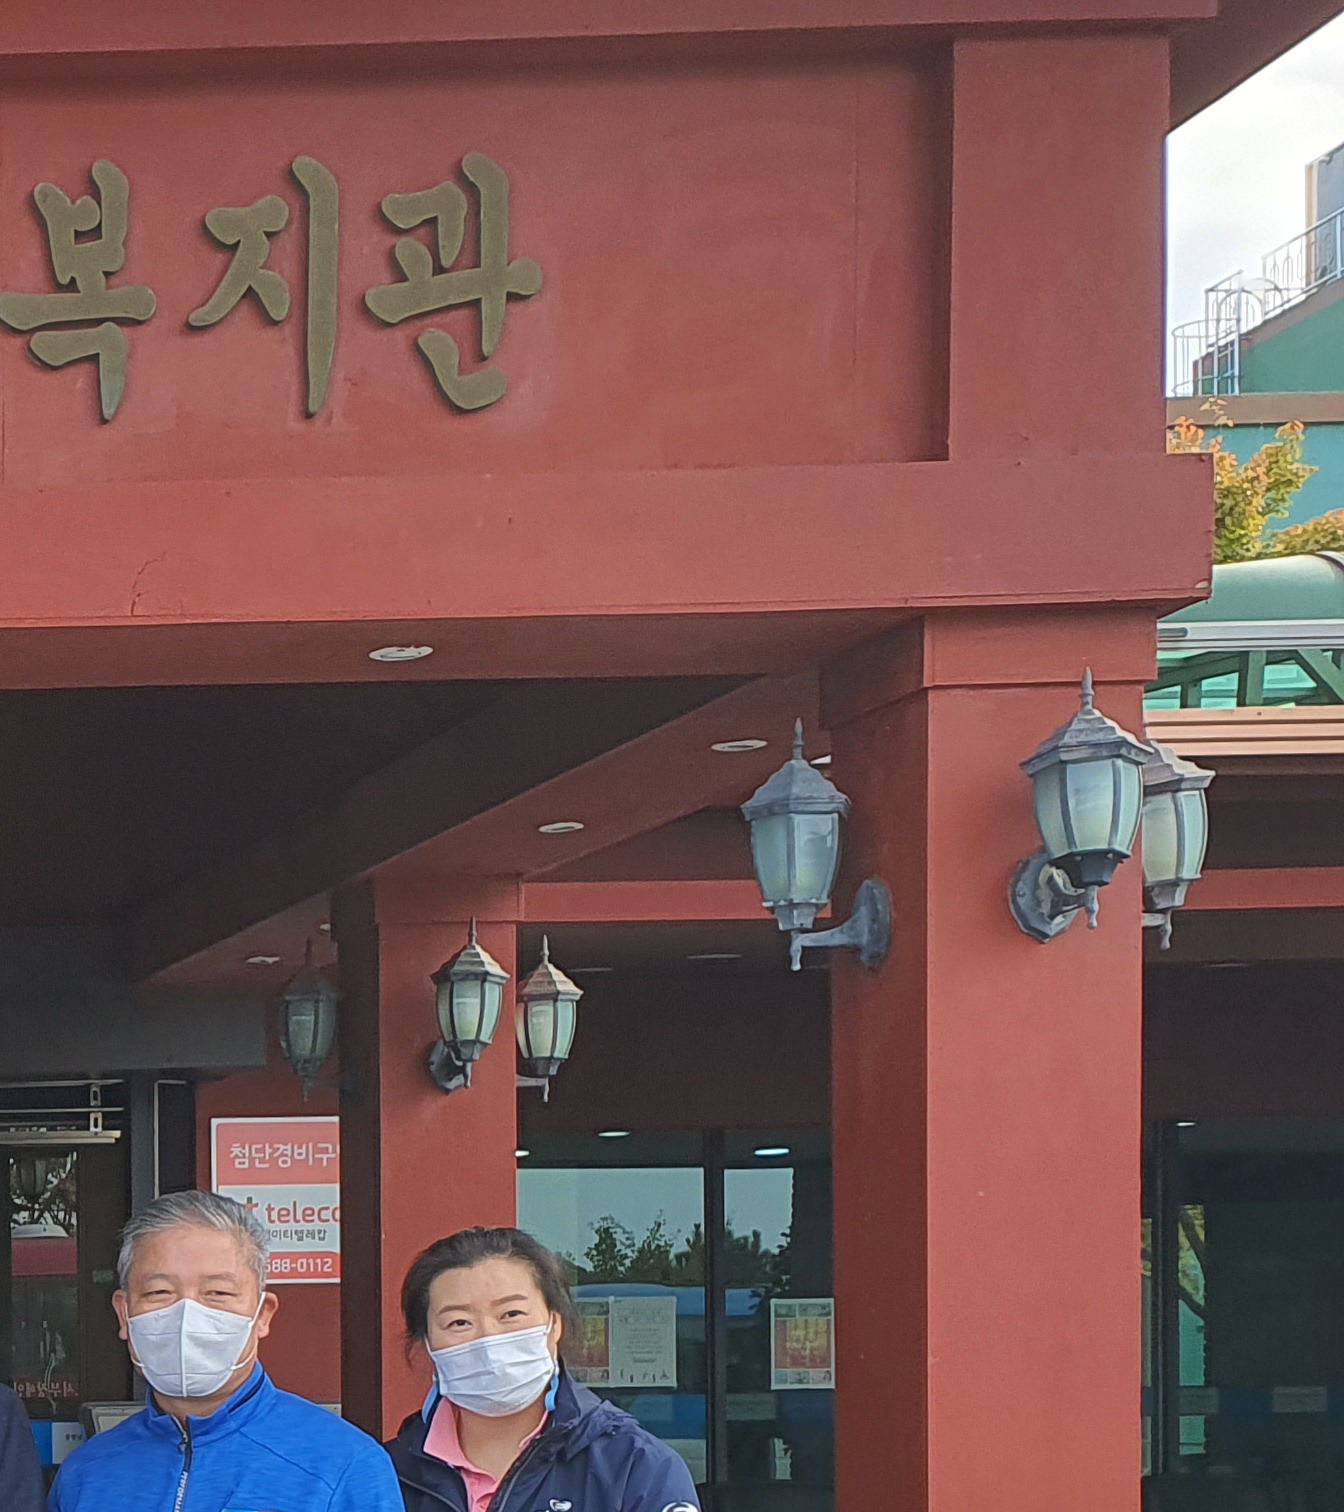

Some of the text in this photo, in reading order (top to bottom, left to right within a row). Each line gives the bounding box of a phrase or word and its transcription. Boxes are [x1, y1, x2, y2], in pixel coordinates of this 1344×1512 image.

[229, 1142, 339, 1169] 첨단경비구
[268, 1229, 327, 1242] 이티텔레캅
[265, 1258, 333, 1273] 588-0112
